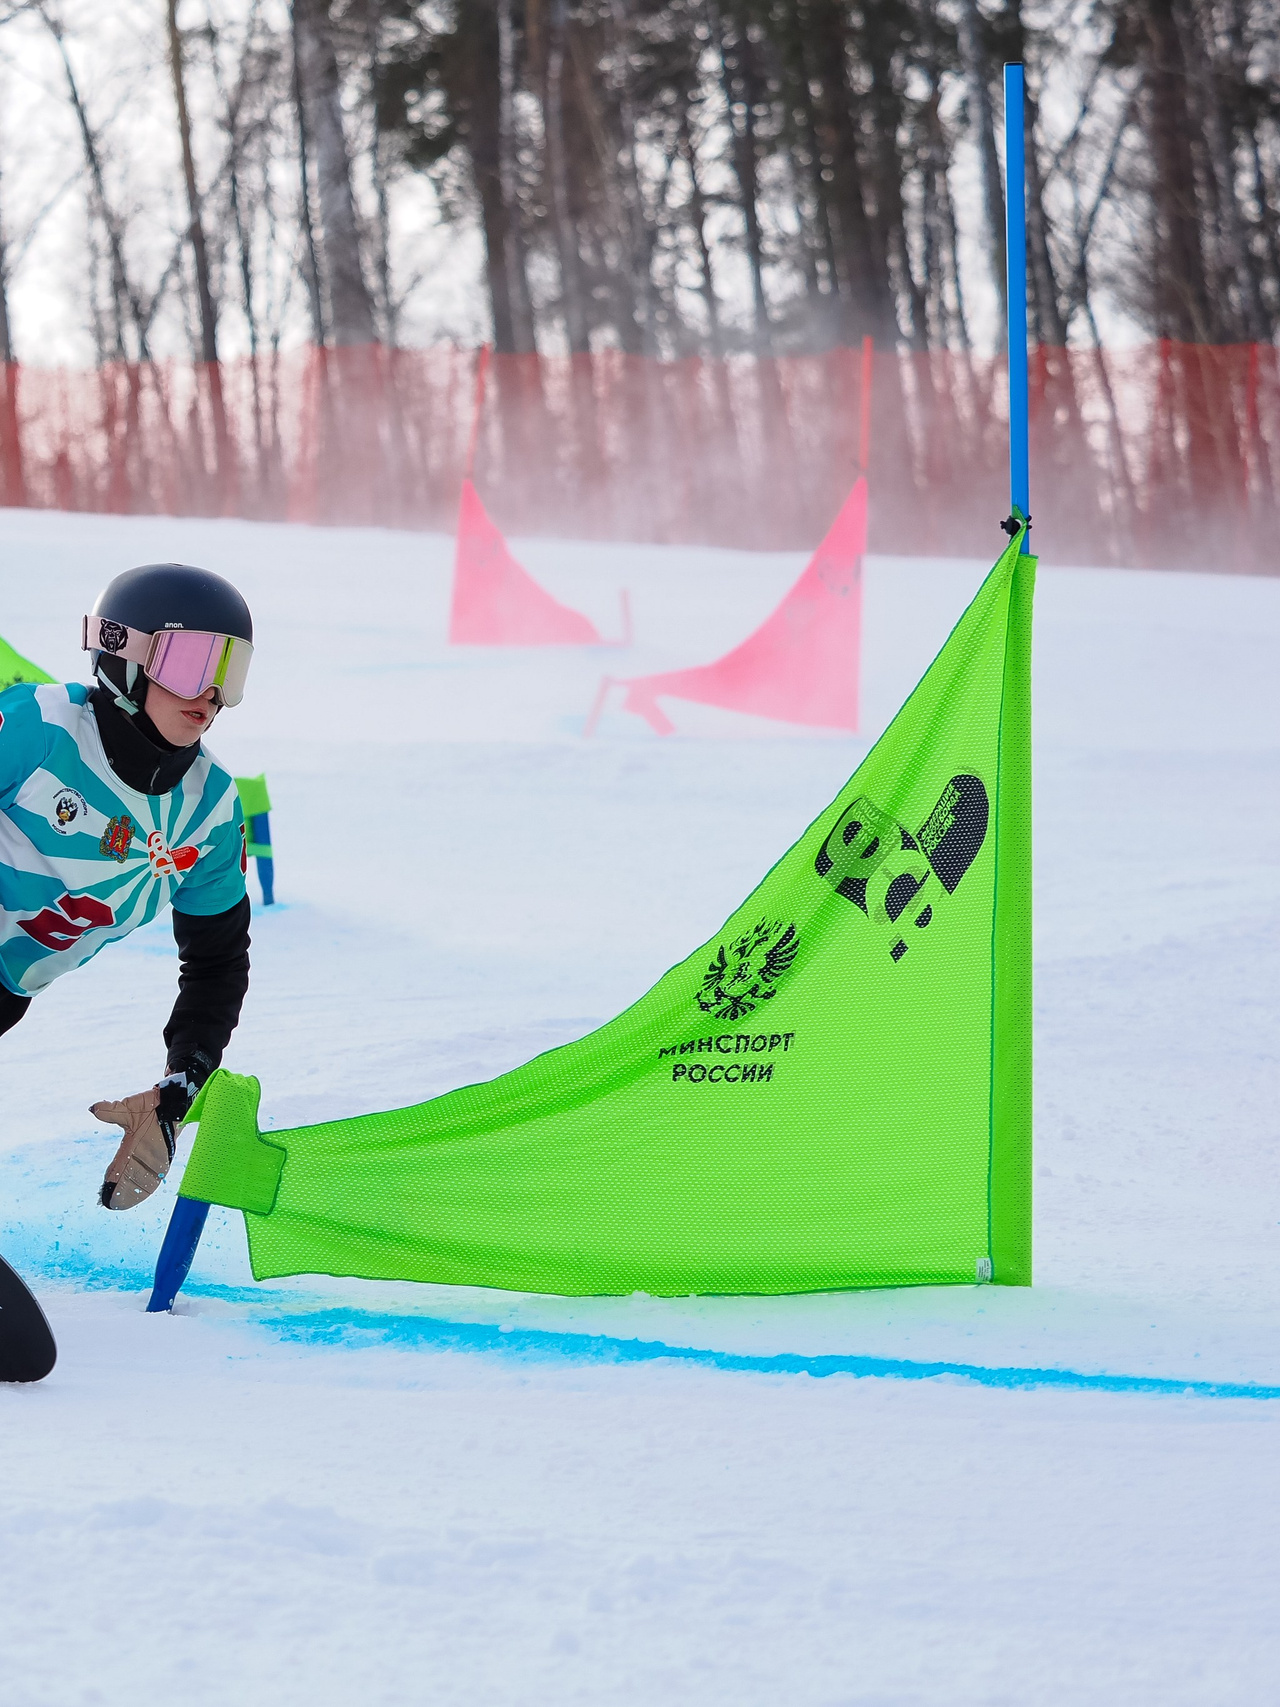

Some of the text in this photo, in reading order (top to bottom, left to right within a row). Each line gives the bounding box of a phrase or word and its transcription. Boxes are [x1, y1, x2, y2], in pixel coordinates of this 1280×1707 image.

[926, 813, 957, 857] РОССИИ
[15, 893, 115, 951] 2
[658, 1032, 795, 1059] МИНСПОРТ
[672, 1063, 774, 1083] РОССИИ
